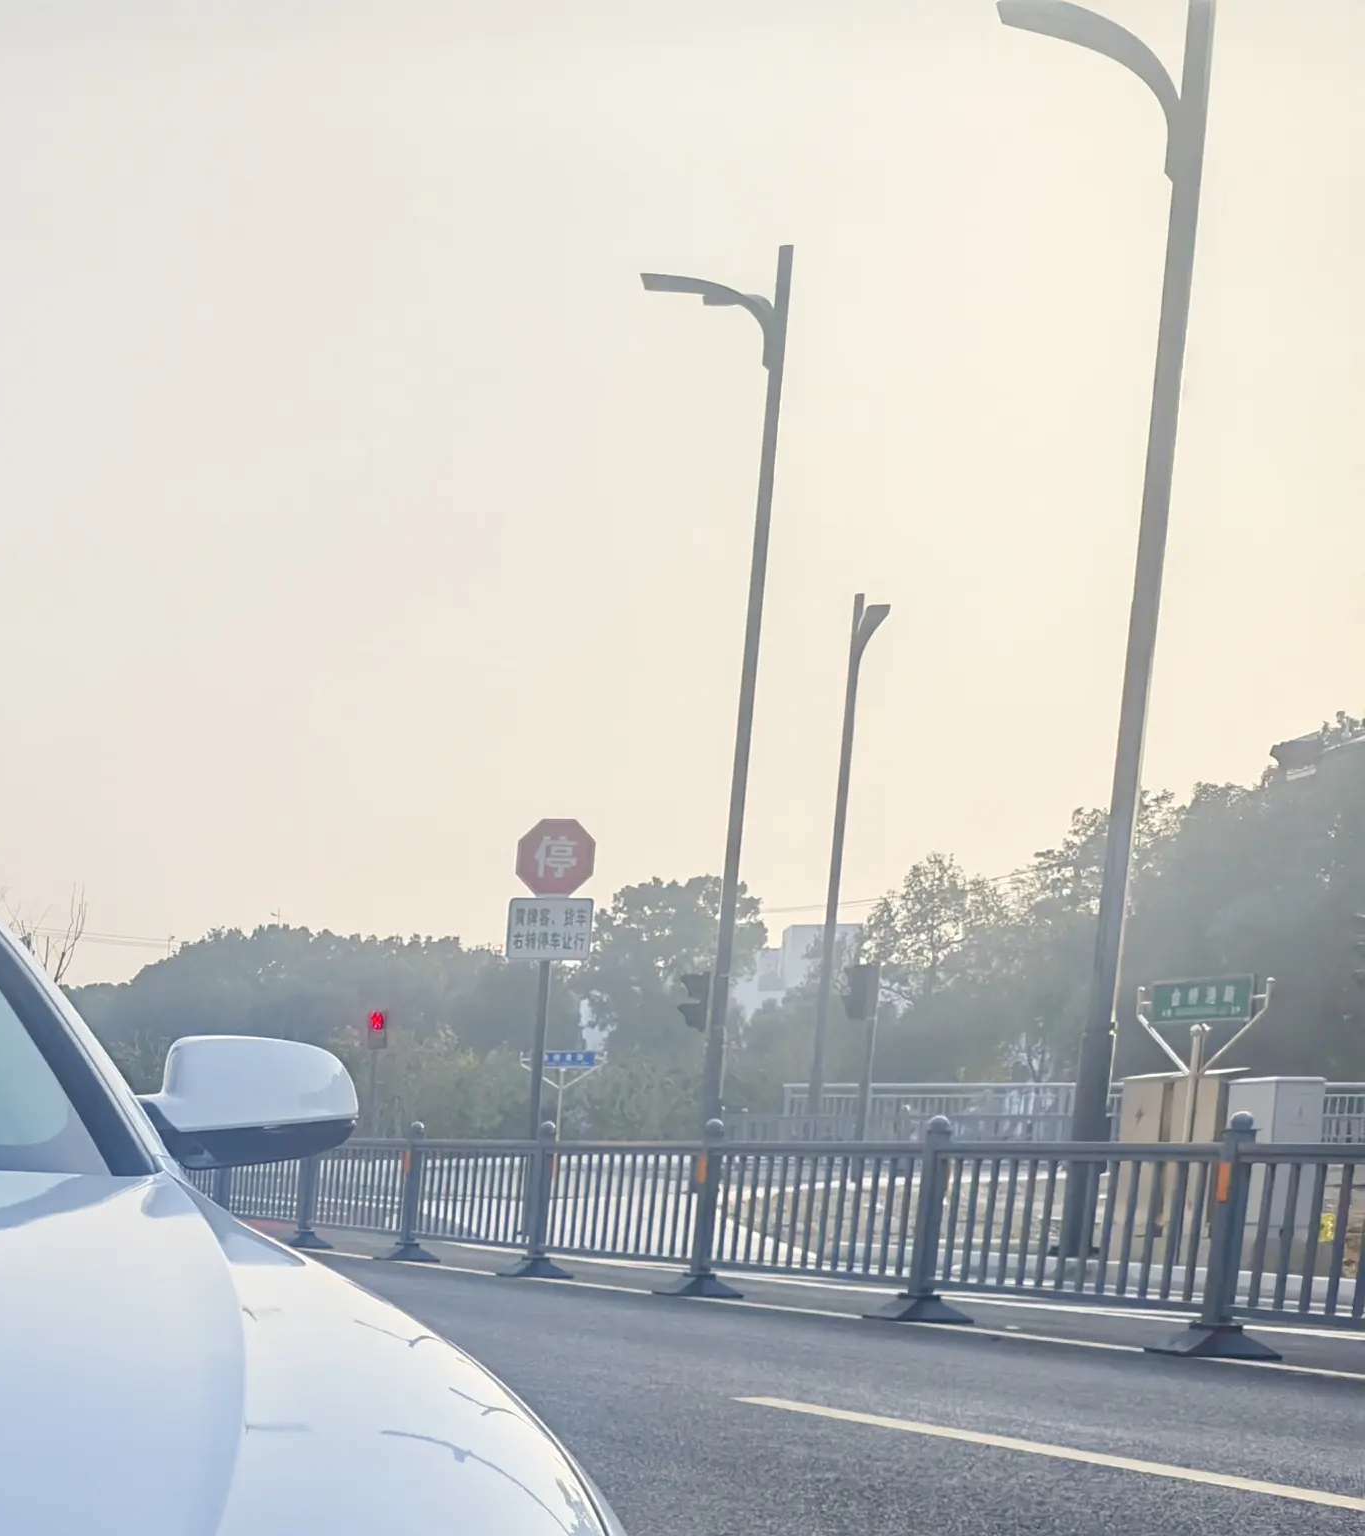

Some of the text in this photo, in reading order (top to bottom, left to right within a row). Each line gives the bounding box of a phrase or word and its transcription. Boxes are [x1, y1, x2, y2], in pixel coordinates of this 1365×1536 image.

[534, 835, 578, 878] 停
[512, 931, 587, 951] 右转停车让行
